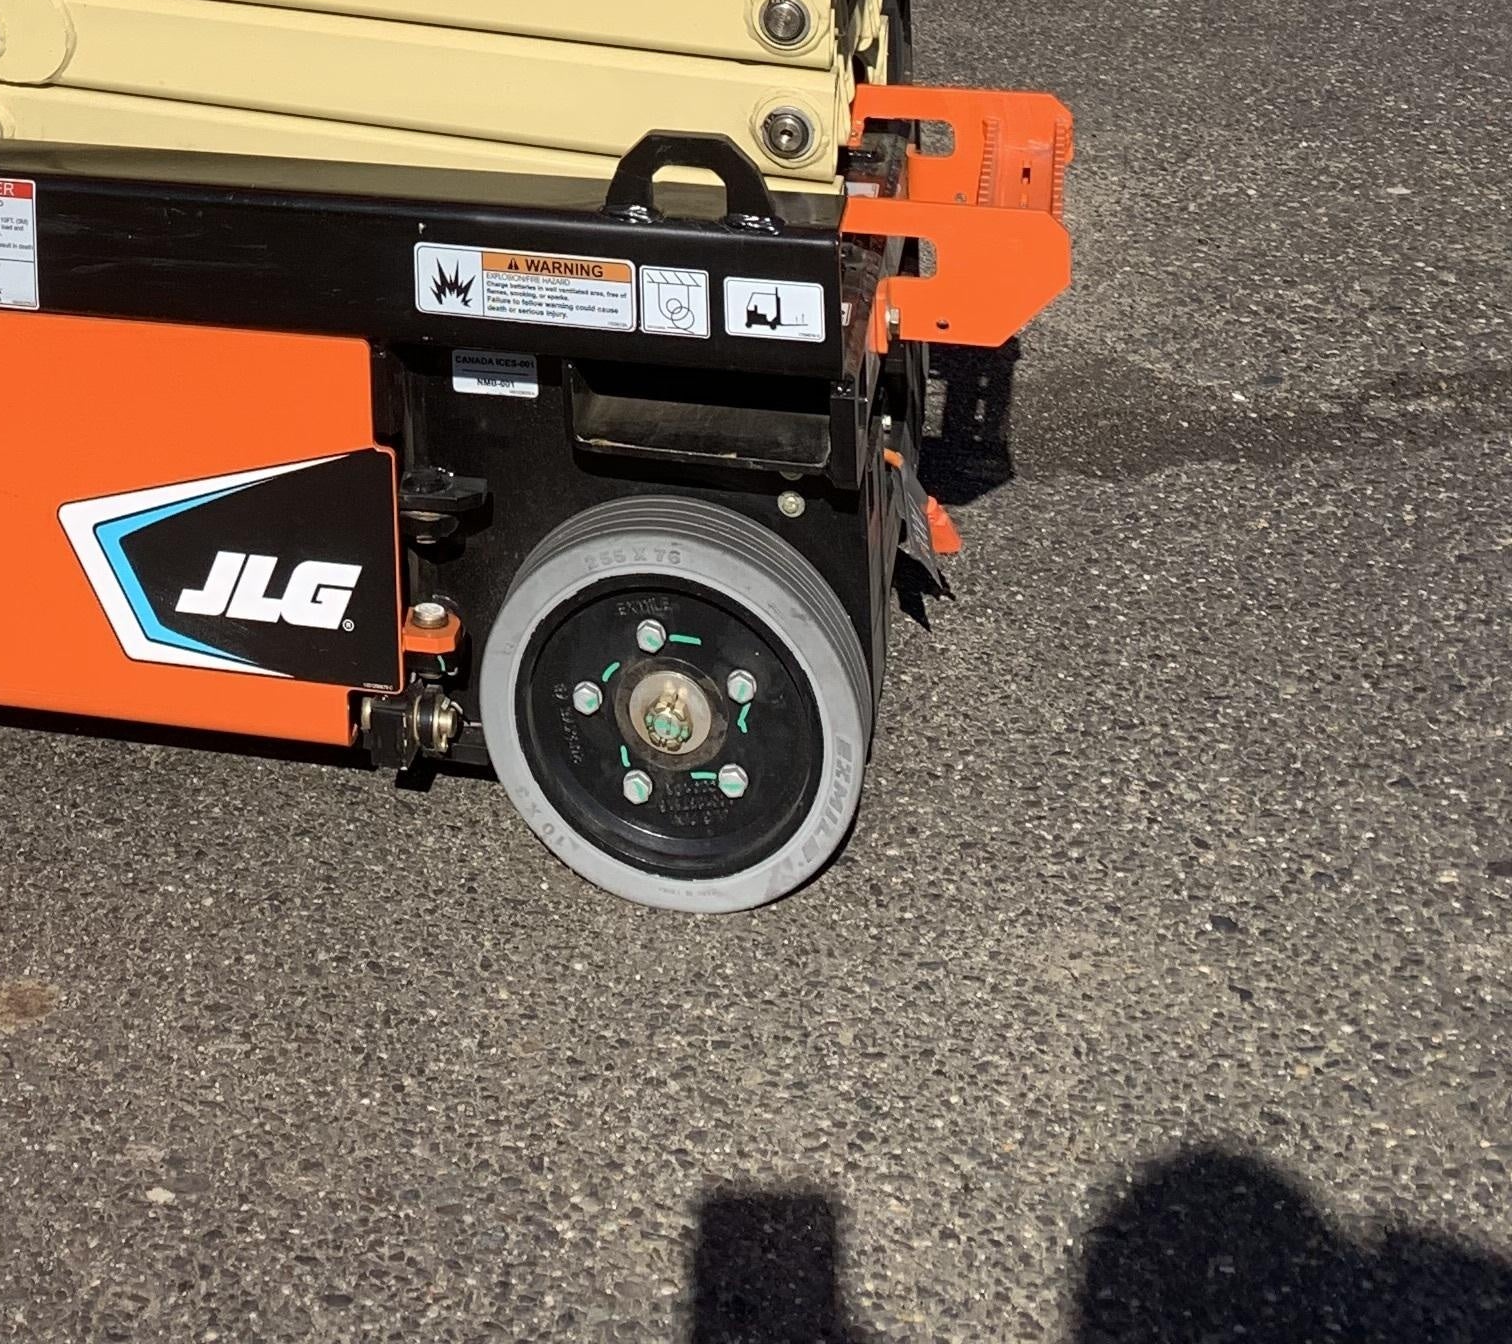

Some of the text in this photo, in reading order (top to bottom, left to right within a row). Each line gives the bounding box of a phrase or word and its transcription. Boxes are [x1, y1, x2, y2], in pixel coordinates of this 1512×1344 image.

[525, 258, 603, 278] WARNING
[487, 280, 508, 289] Charge
[510, 282, 536, 291] batteries
[559, 287, 588, 295] ventilated
[607, 290, 619, 298] free
[542, 277, 571, 286] HAZARD
[510, 290, 537, 299] smoking,
[487, 304, 507, 312] death
[518, 308, 544, 316] serious
[546, 310, 568, 319] injury.
[488, 296, 511, 304] Failure
[522, 299, 543, 307] follow
[545, 302, 574, 311] warning
[576, 303, 596, 311] could
[597, 306, 619, 314] cause
[455, 355, 534, 368] CANADA ICES-001
[584, 546, 681, 570] 255 X 76
[175, 550, 362, 630] JLG
